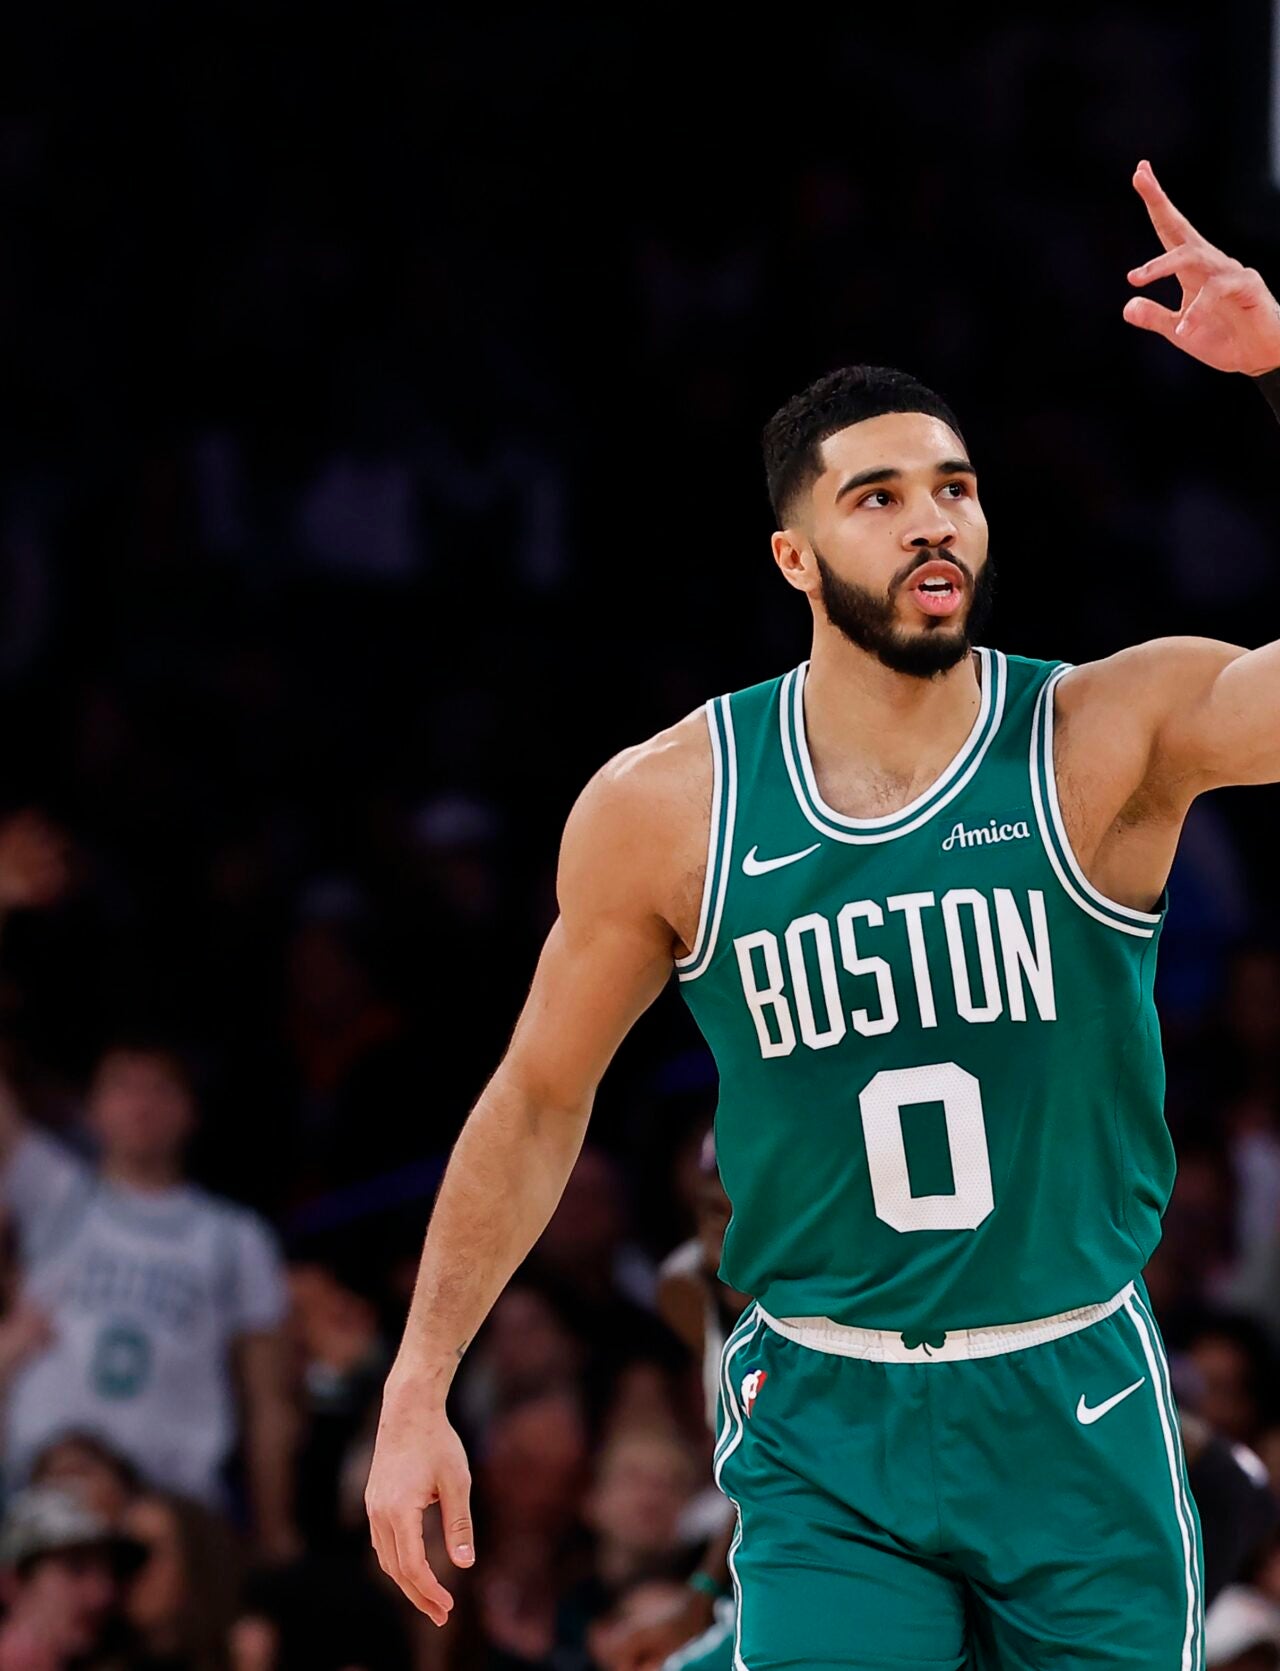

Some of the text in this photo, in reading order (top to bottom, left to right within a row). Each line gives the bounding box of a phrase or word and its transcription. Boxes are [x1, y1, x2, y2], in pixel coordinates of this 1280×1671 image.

[942, 820, 1031, 851] Amica
[733, 888, 1058, 1060] BOSTON
[858, 1061, 995, 1234] 0
